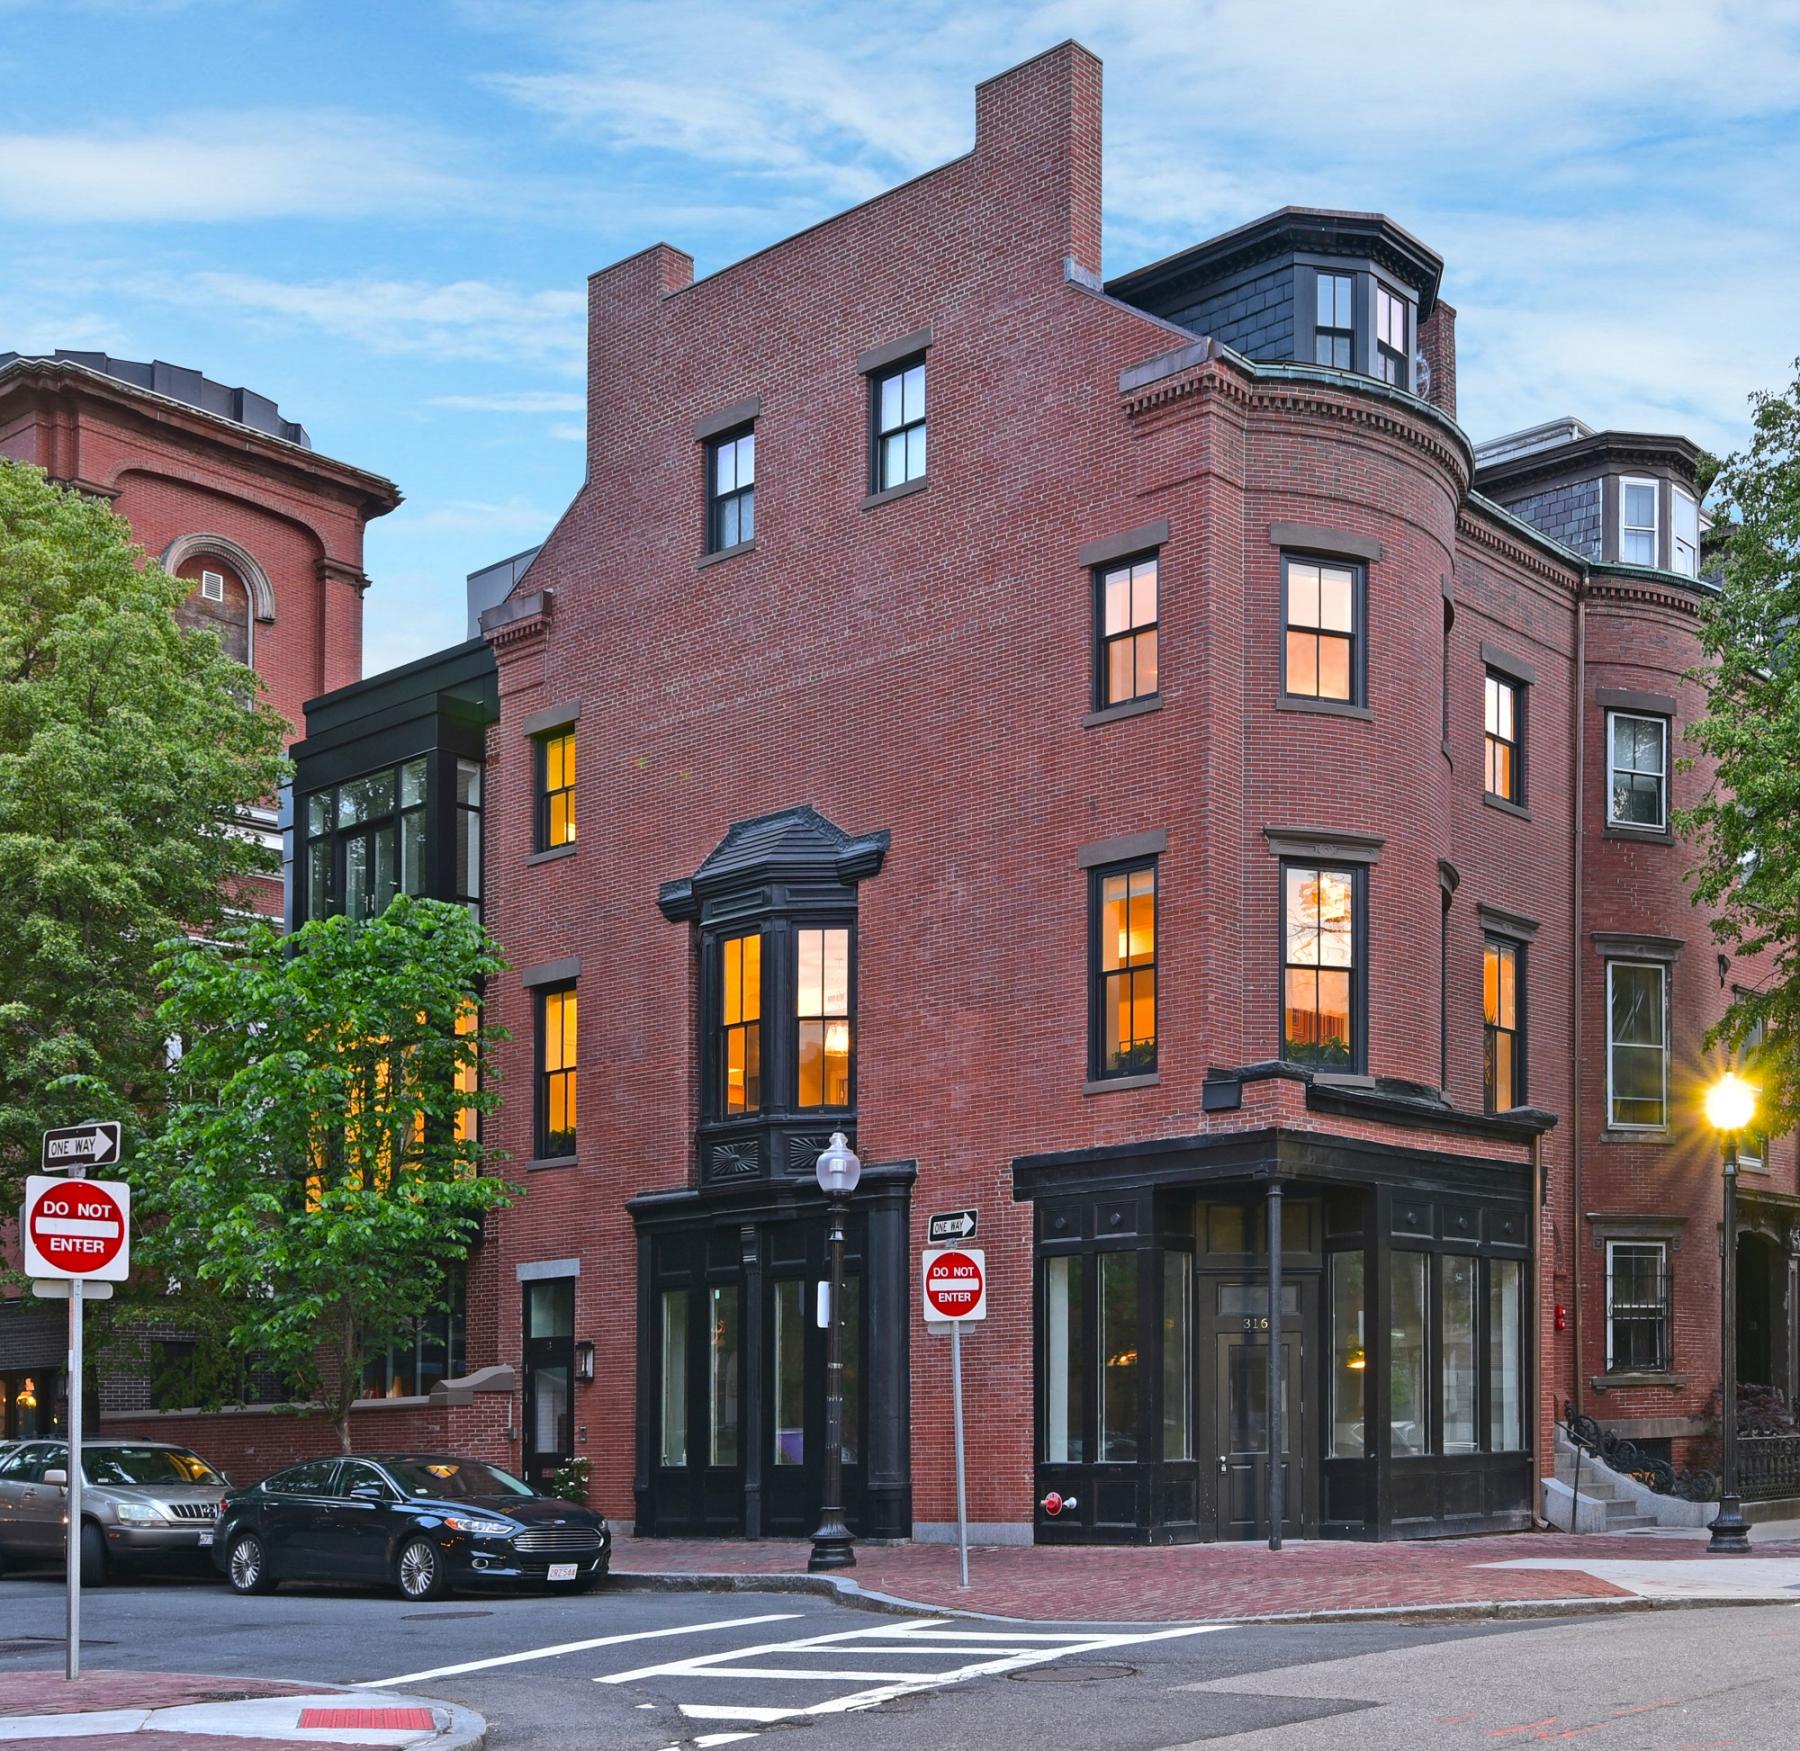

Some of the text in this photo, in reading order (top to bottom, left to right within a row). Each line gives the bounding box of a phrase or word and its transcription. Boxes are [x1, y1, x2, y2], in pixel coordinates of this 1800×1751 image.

[51, 1138, 96, 1156] ONE WAY
[43, 1200, 112, 1219] DO NOT
[934, 1220, 963, 1233] ONE WAY
[50, 1237, 104, 1254] ENTER
[933, 1266, 974, 1277] DO NOT
[938, 1292, 971, 1302] ENTER
[1243, 1318, 1268, 1328] 316
